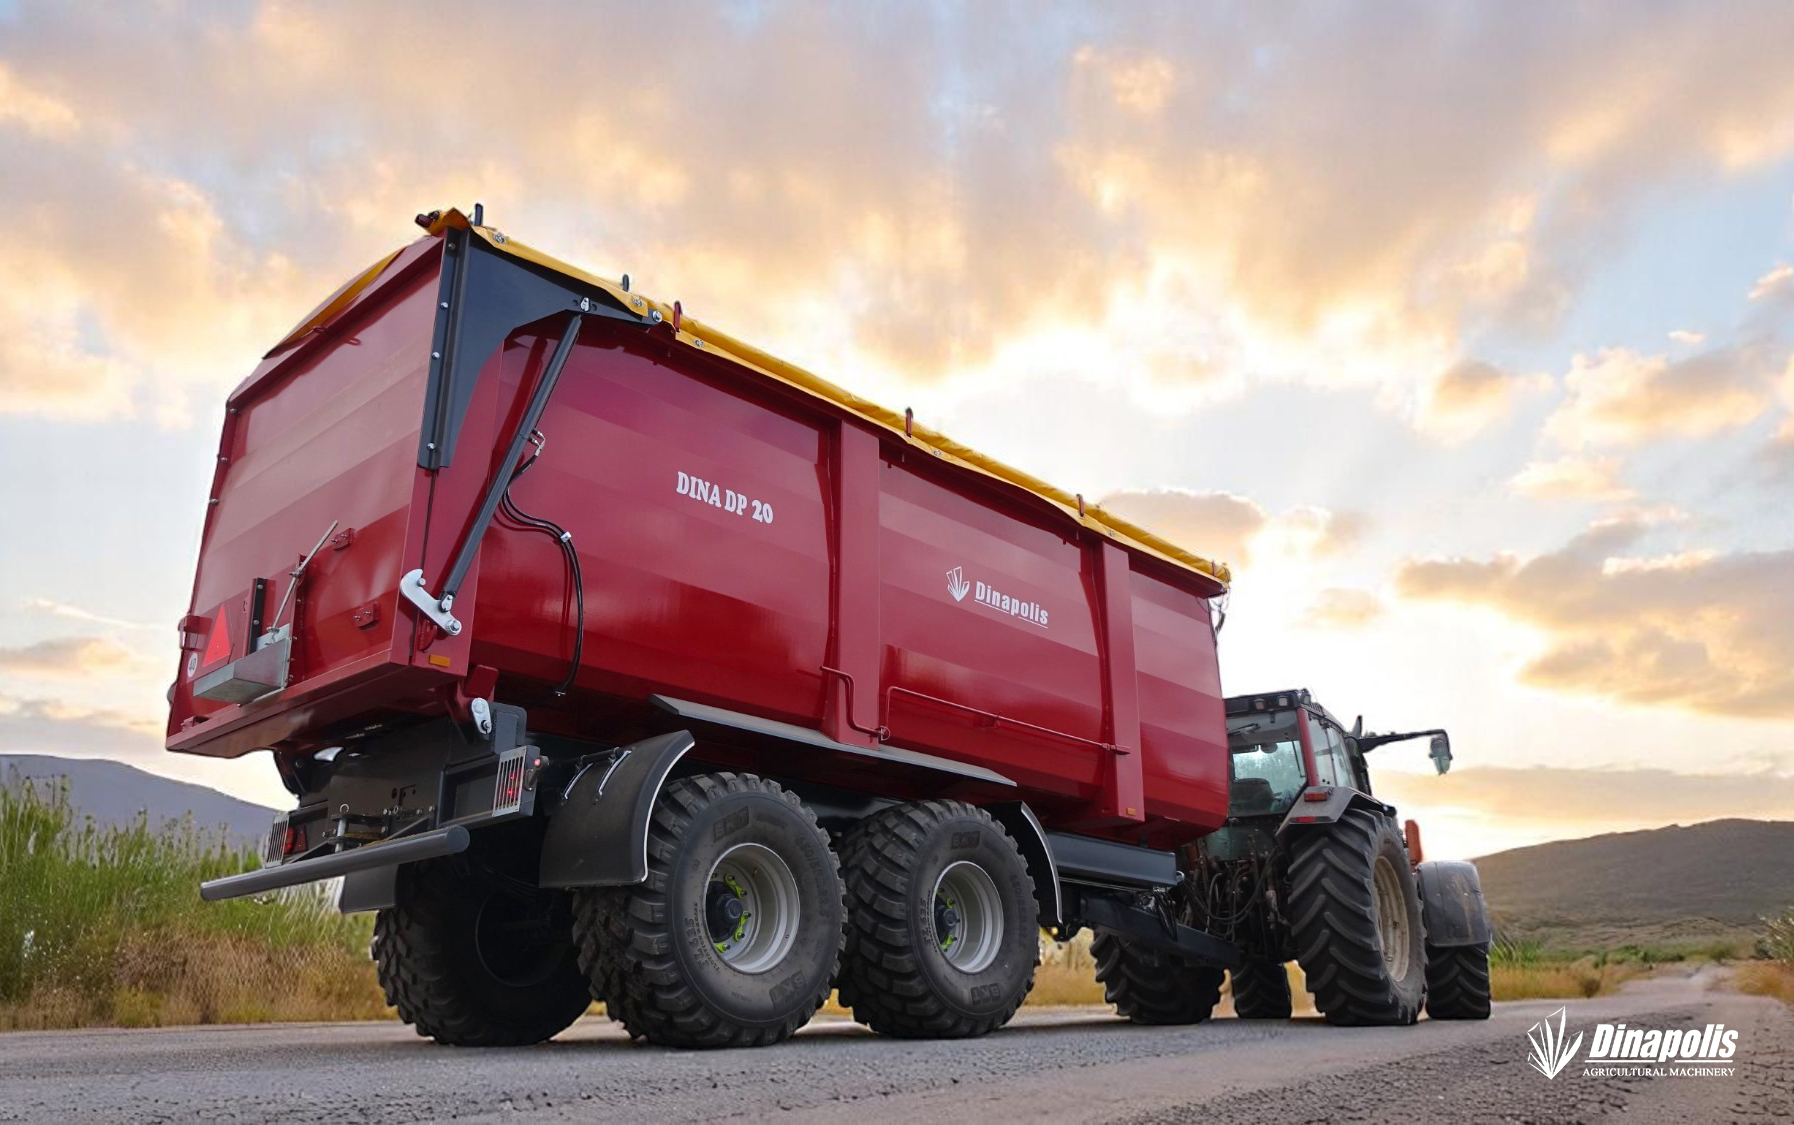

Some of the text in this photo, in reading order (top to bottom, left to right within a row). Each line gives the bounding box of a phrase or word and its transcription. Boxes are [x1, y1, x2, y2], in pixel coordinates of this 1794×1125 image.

[676, 471, 774, 524] DINA DP 20
[975, 581, 1049, 625] Dinapolis
